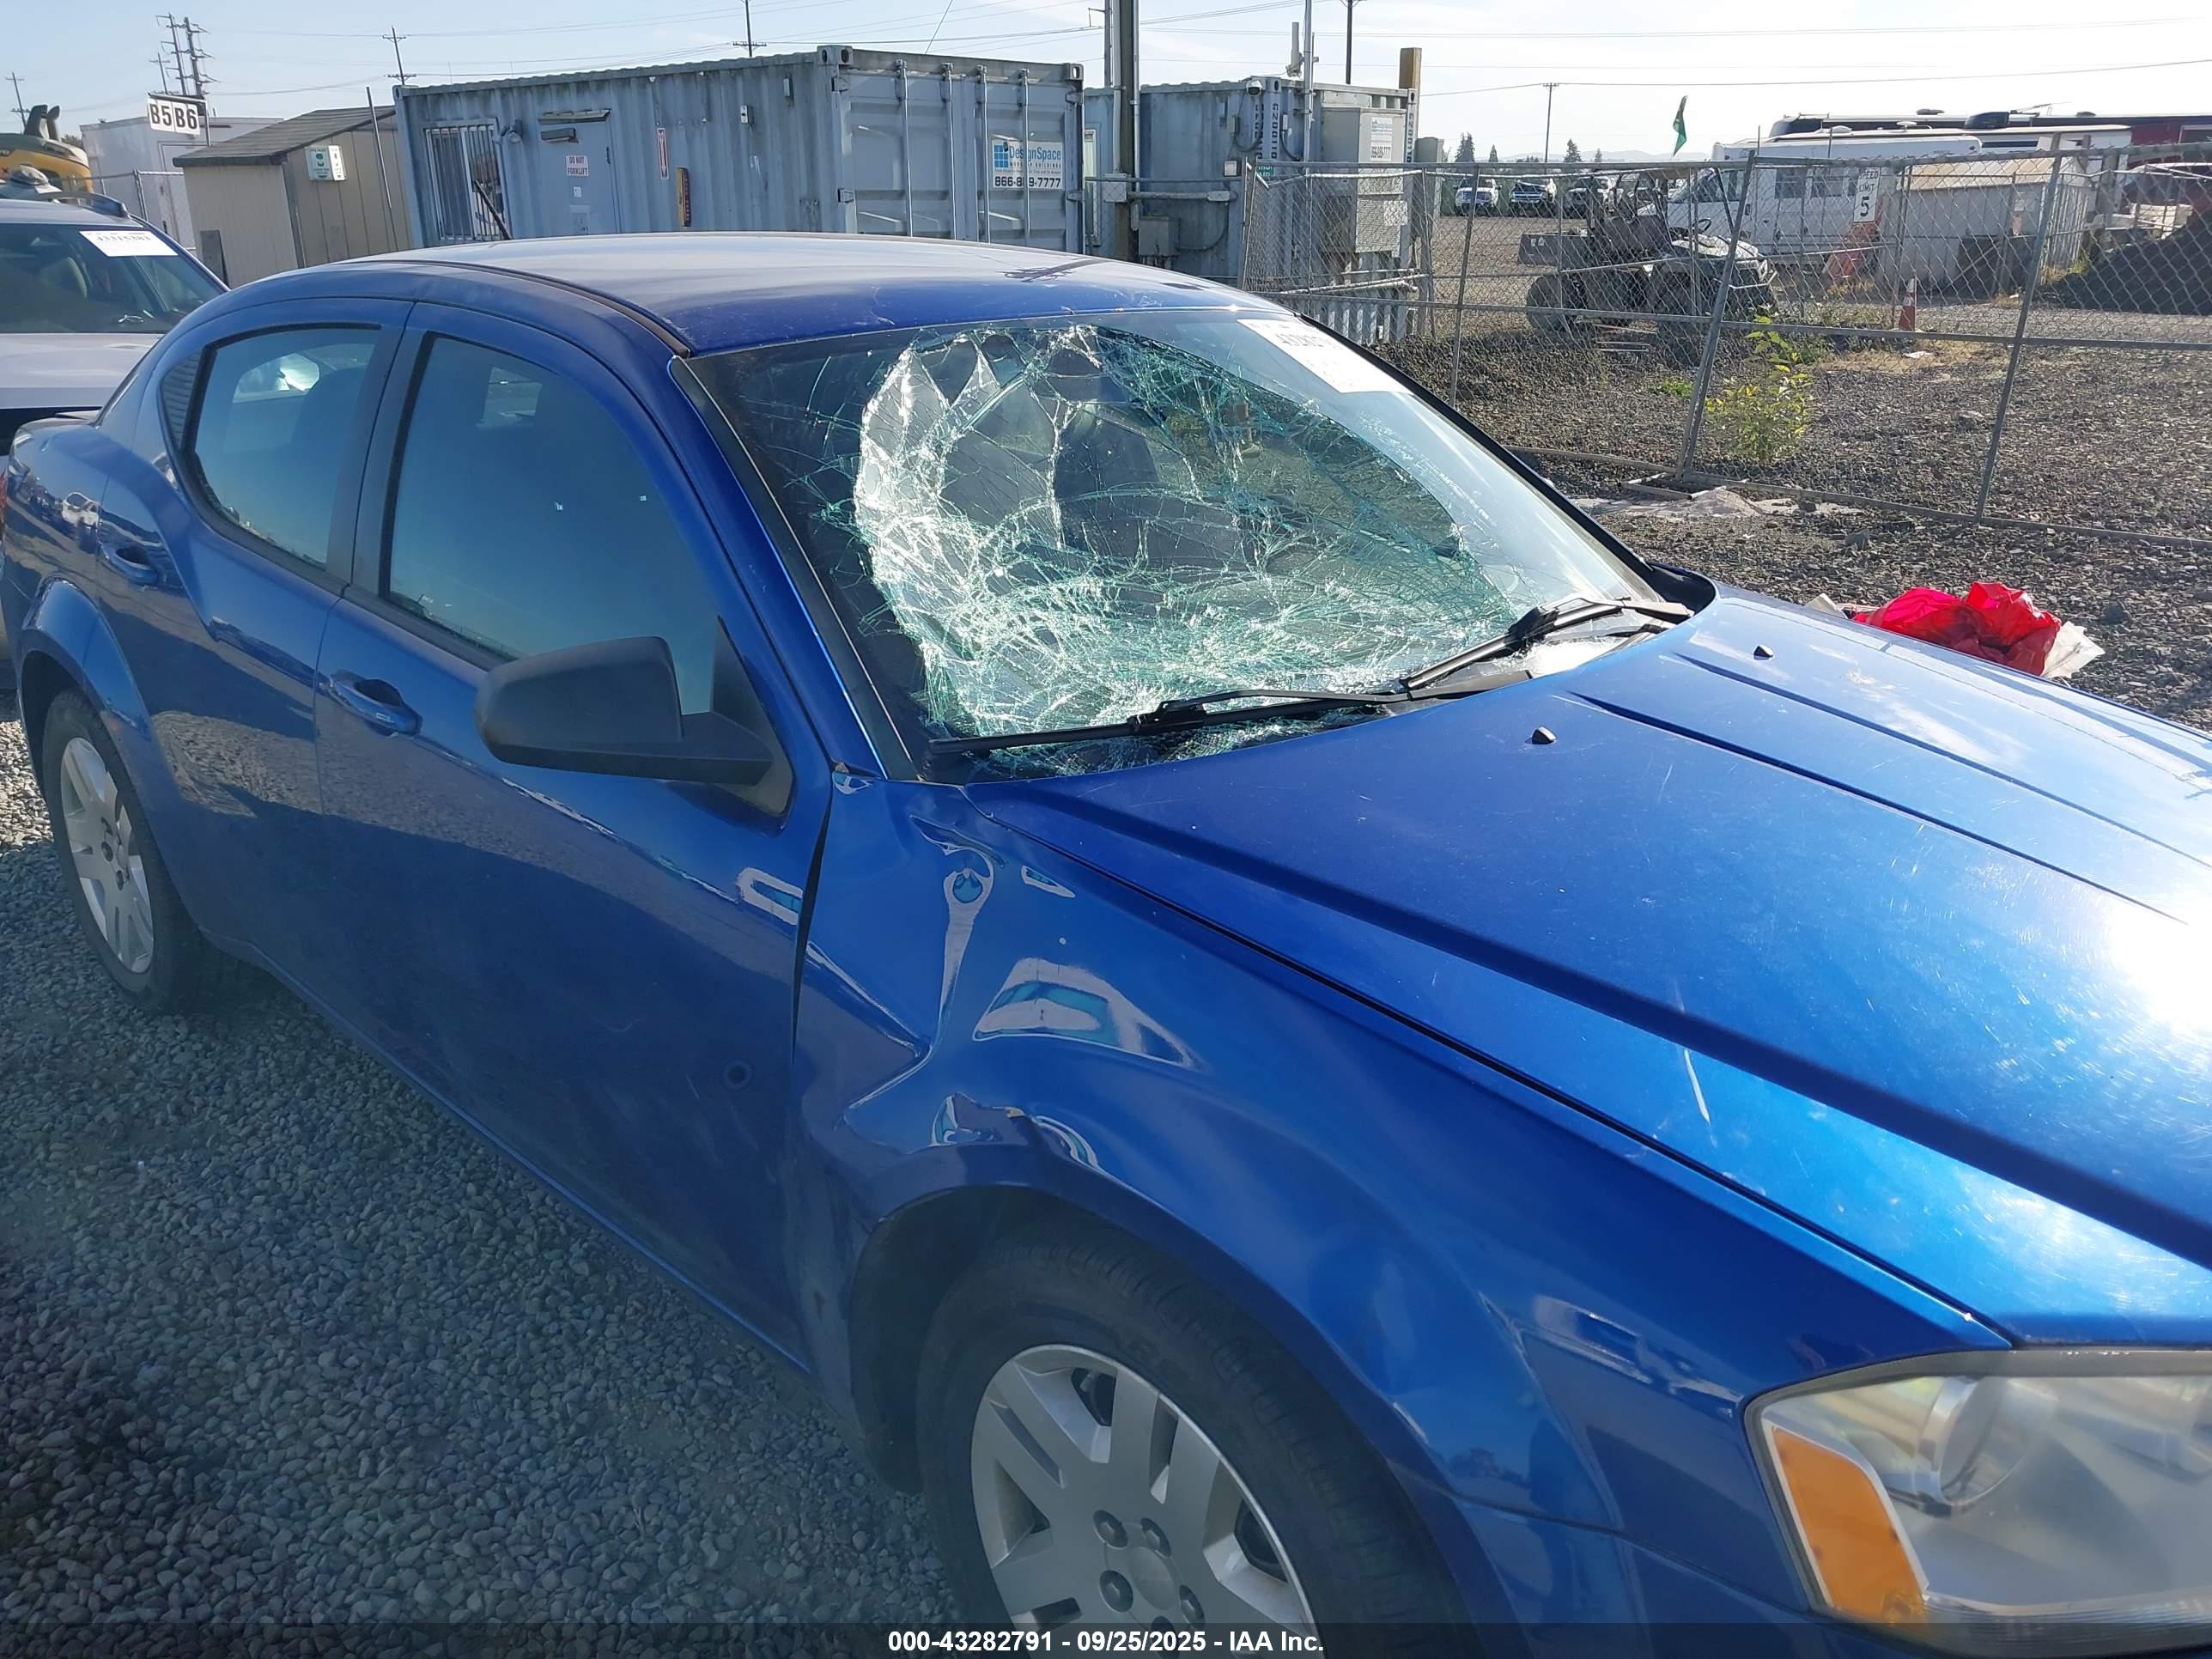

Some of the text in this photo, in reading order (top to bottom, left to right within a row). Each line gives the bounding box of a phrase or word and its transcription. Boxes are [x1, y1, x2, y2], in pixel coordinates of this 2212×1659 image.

[149, 103, 198, 130] B5 B6
[1009, 145, 1061, 162] DesgnSpace
[994, 176, 1061, 187] 866-89-7777
[1860, 196, 1869, 216] 5
